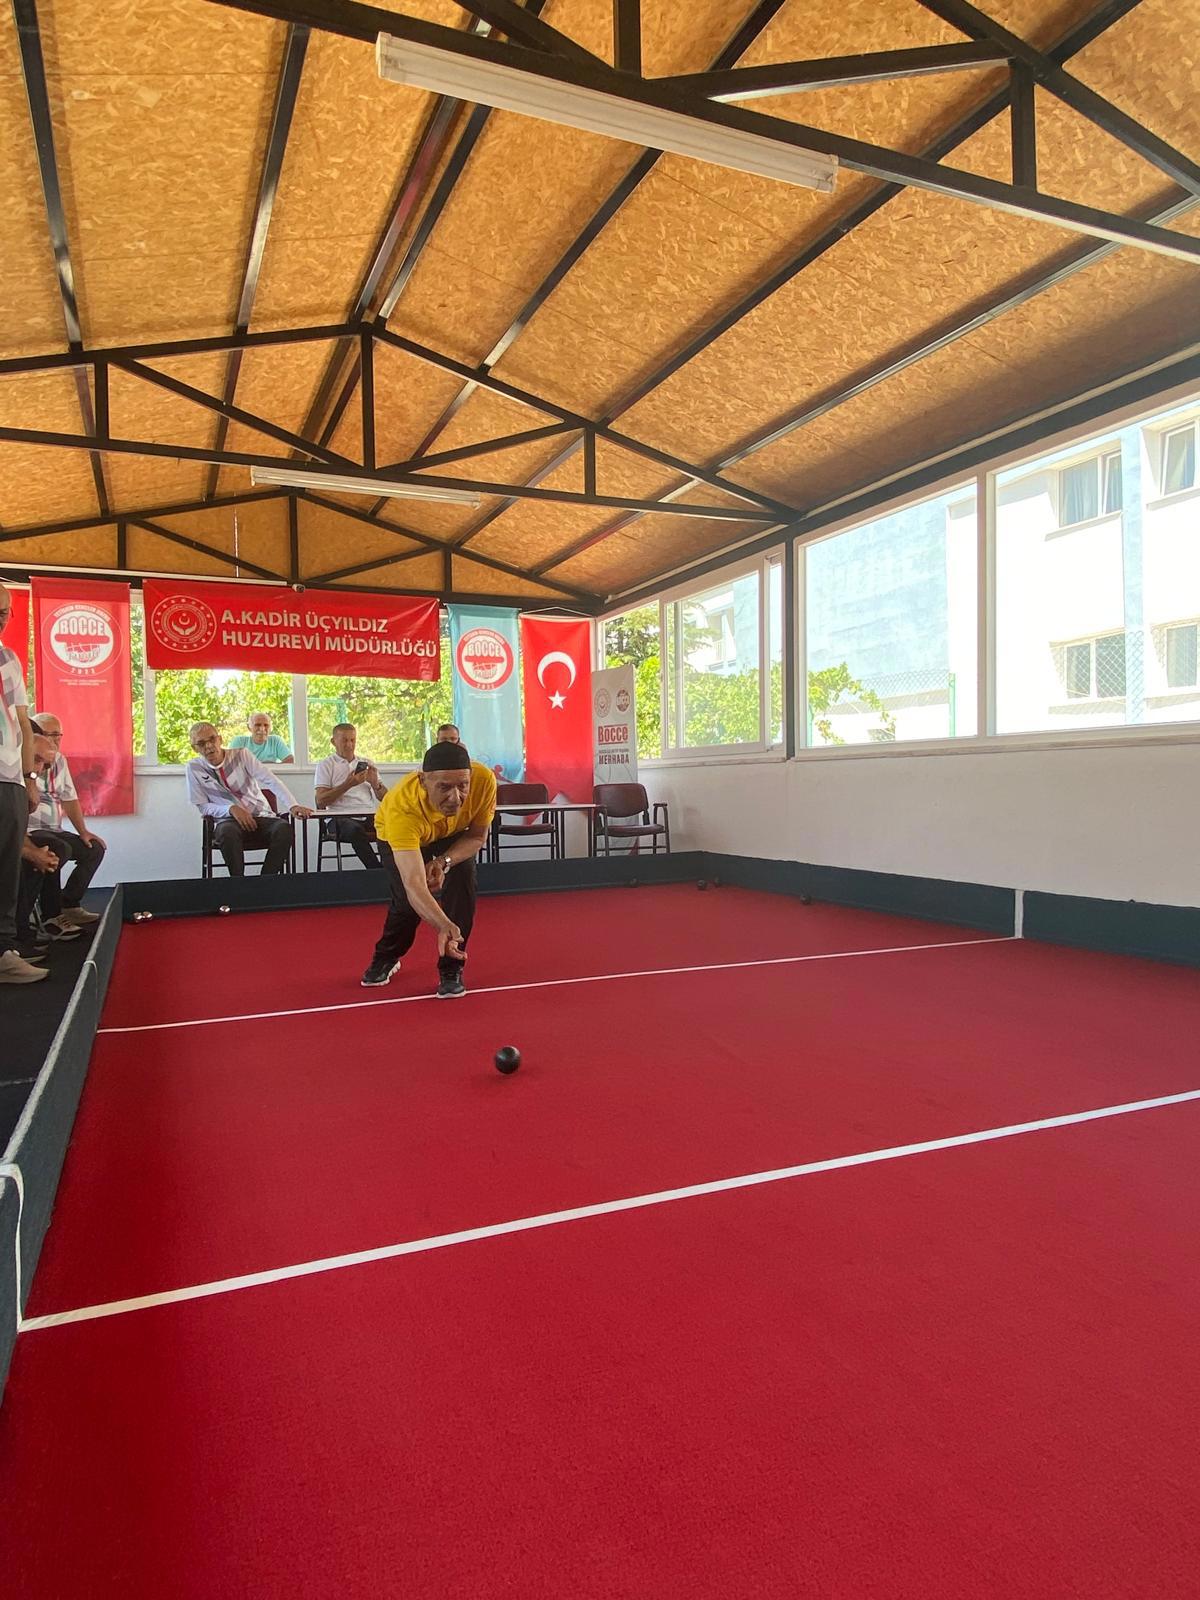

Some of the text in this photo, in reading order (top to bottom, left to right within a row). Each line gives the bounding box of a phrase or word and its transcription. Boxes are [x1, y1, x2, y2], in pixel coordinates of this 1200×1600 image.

[58, 616, 106, 636] BOCCE
[221, 609, 301, 627] A.KADİR
[305, 611, 388, 633] ÜÇYILDIZ
[222, 630, 320, 651] HUZUREVİ
[325, 634, 437, 658] MÜDÜRLÜĞÜ
[467, 640, 502, 657] BOCCE
[598, 754, 630, 765] MERHABA
